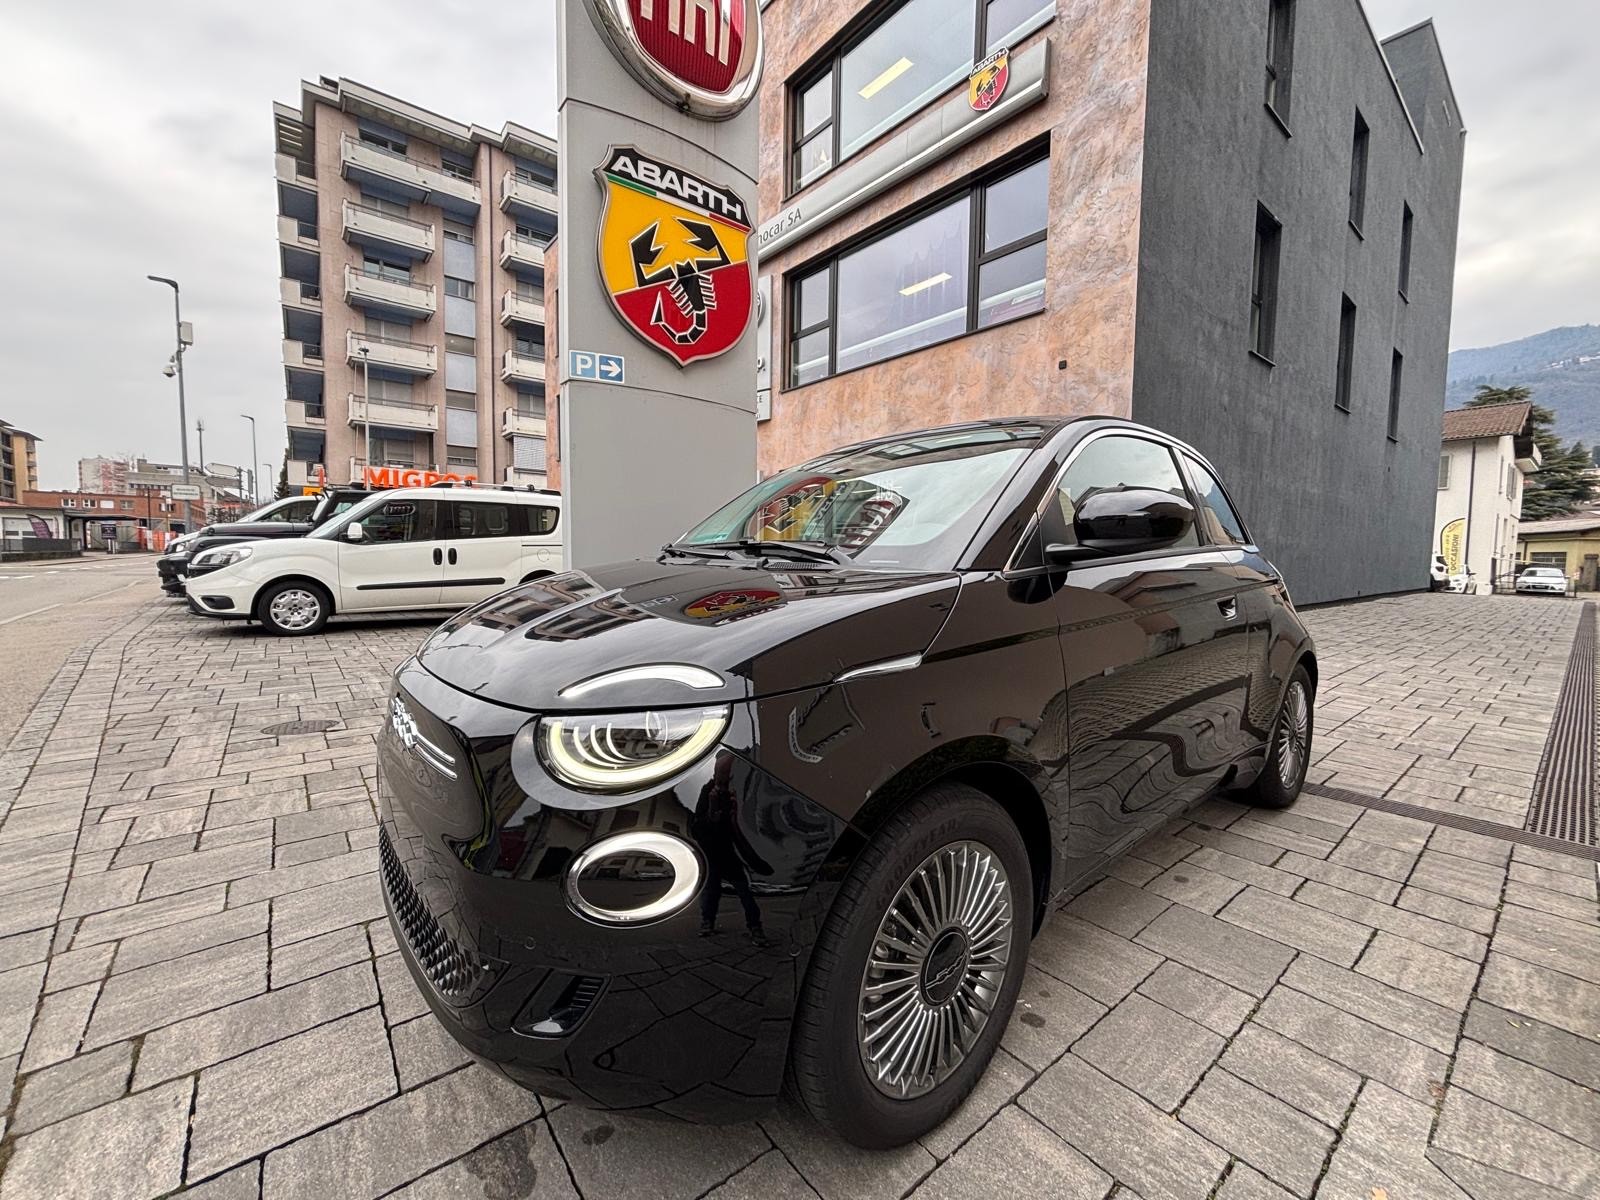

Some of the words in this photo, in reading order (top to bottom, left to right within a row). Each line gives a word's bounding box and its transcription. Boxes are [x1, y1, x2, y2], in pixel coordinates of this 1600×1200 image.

[610, 155, 742, 221] ABARTH
[787, 207, 802, 227] SA
[575, 354, 593, 376] P
